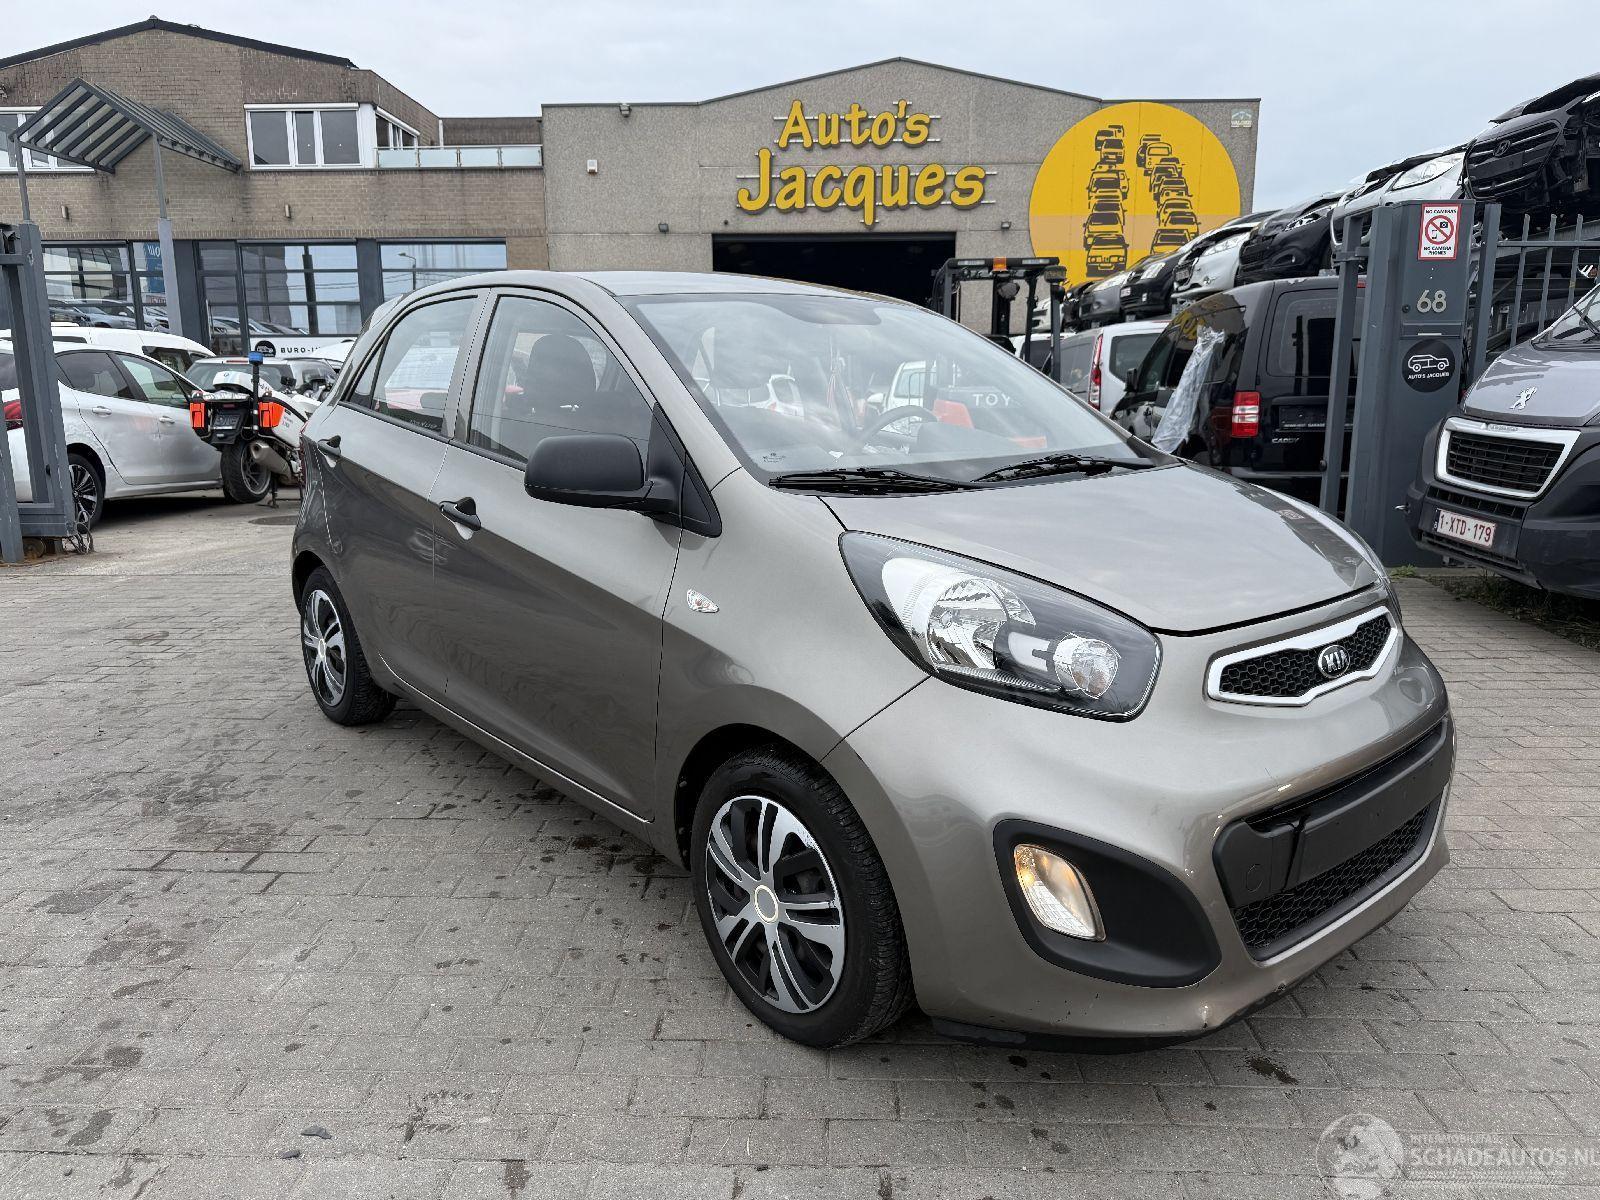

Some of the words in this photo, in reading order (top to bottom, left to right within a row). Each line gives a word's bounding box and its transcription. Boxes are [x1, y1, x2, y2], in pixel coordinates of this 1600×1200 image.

[778, 99, 931, 149] Auto's
[737, 148, 987, 227] Jacques
[1416, 289, 1447, 313] 68
[1426, 371, 1450, 379] JACQUES
[1440, 513, 1492, 543] 1-XTD-179
